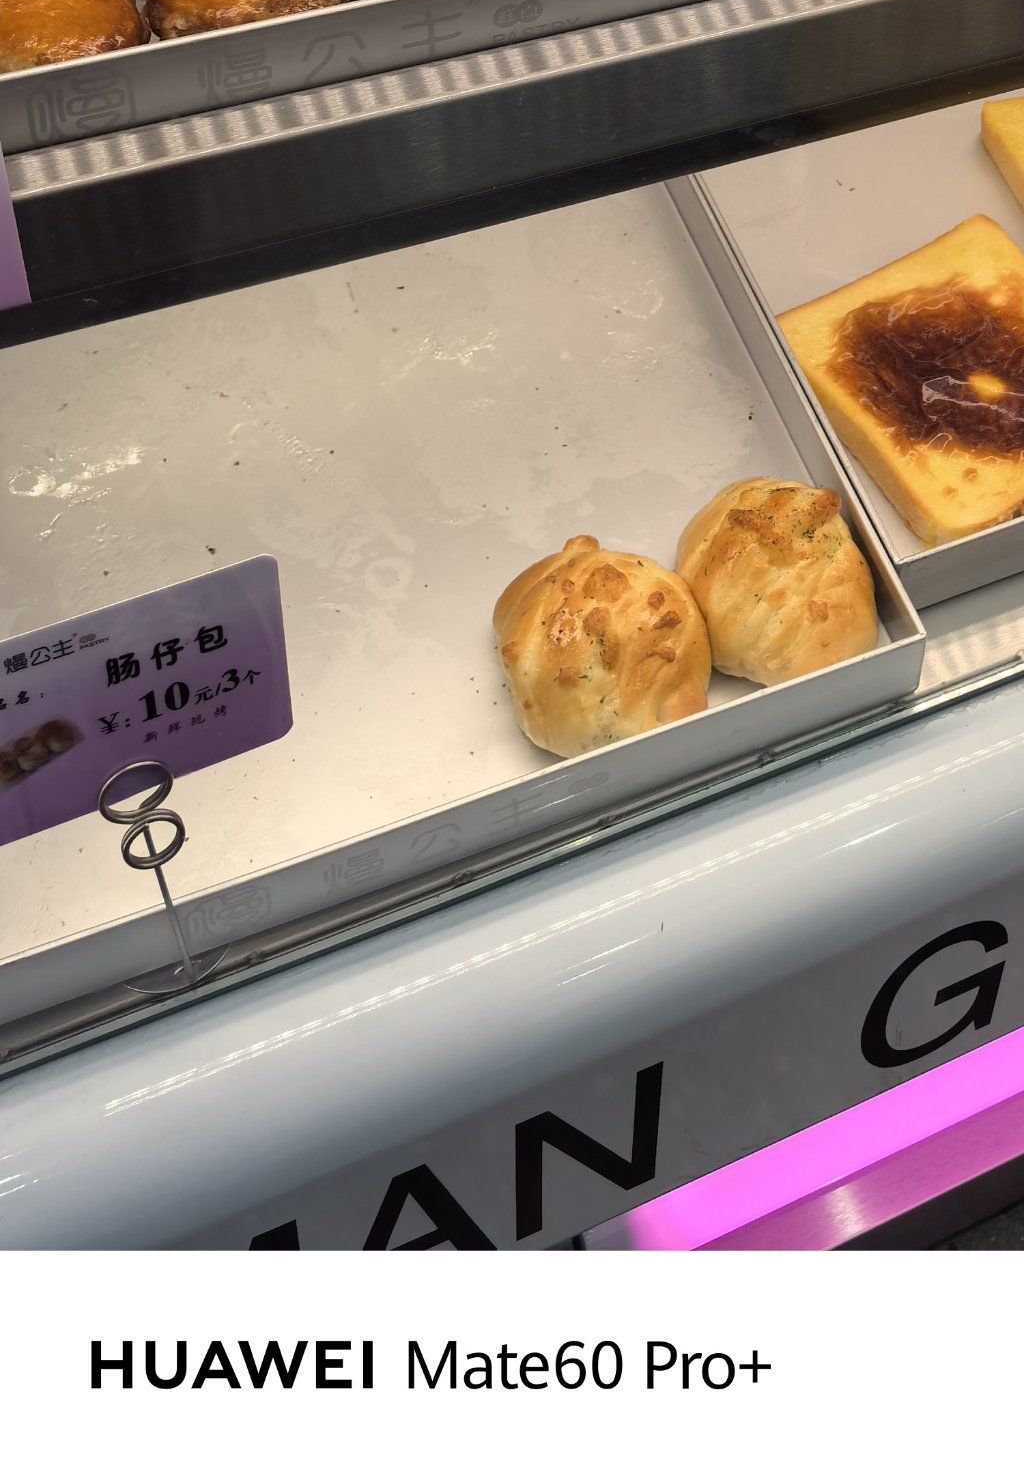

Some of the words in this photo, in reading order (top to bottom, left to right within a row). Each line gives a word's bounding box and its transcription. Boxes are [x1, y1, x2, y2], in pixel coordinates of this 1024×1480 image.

[79, 636, 110, 650] PASTRY
[105, 625, 229, 687] 肠仔包
[248, 1061, 664, 1250] AN
